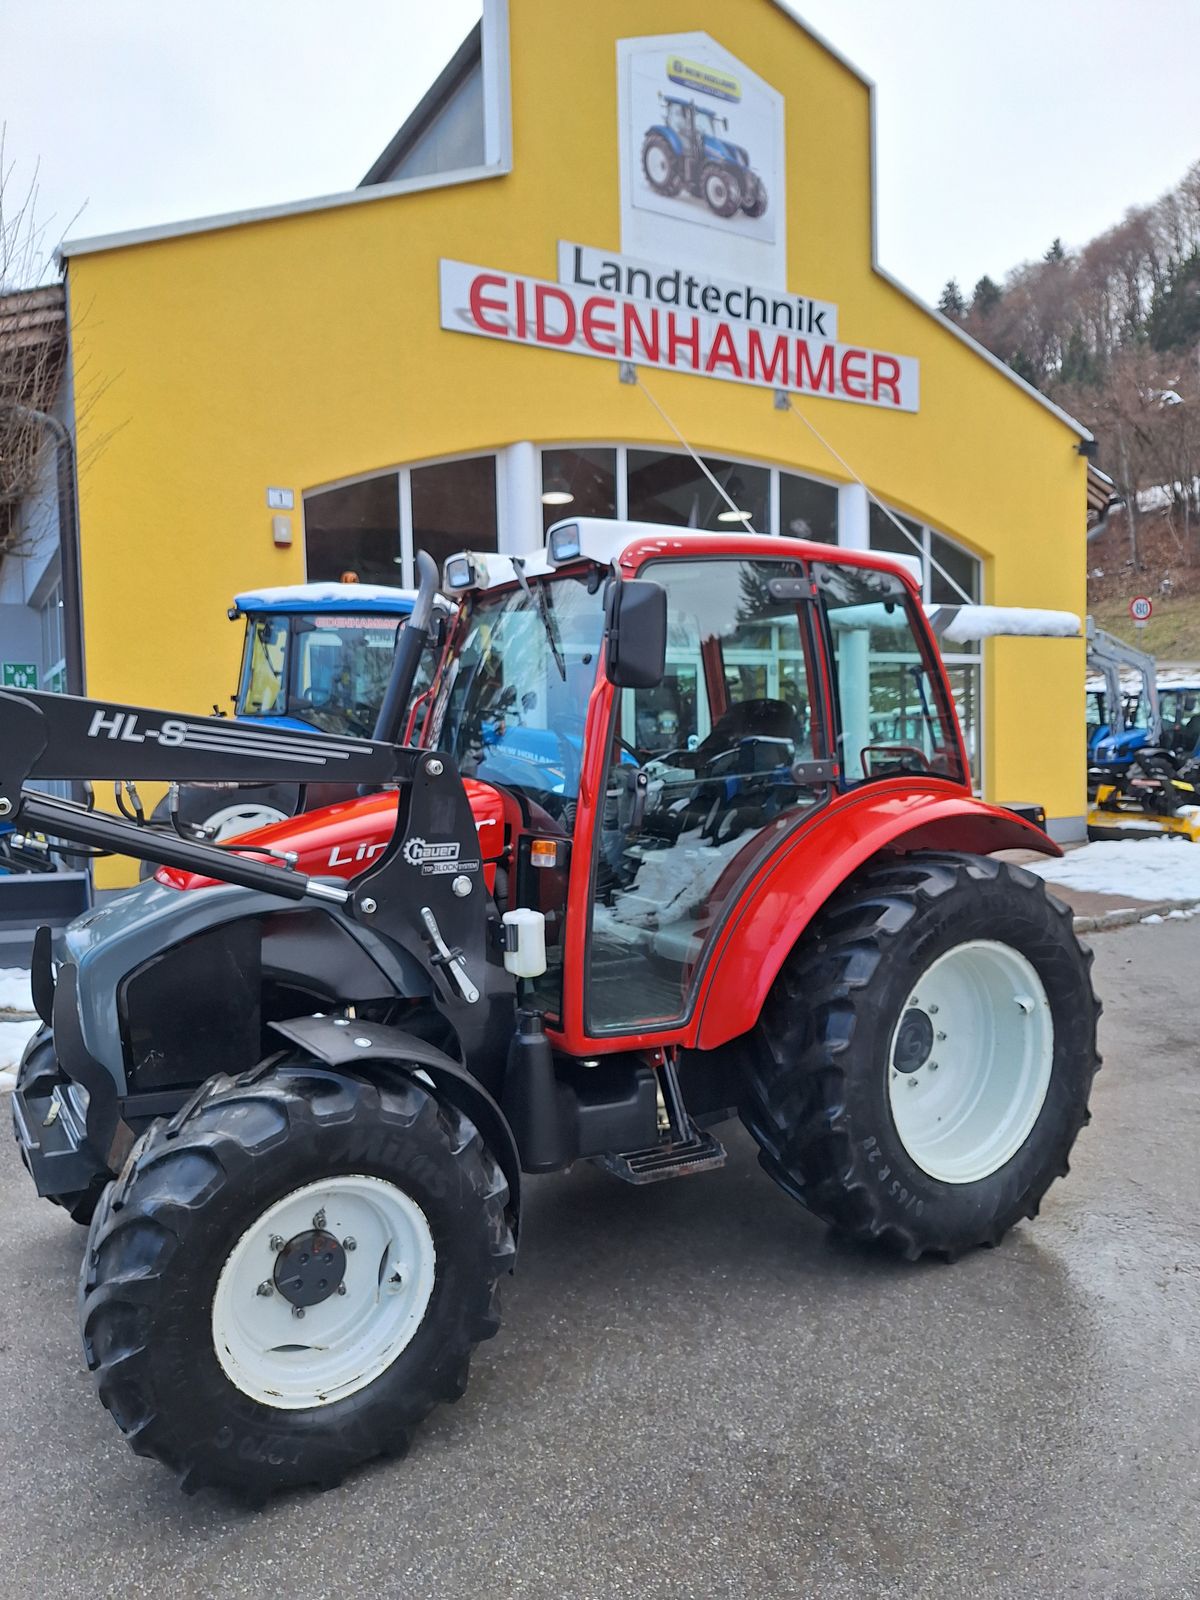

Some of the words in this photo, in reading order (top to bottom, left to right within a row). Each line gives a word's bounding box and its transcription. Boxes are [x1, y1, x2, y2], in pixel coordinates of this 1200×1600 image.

[572, 245, 827, 336] Landtechnik
[469, 273, 902, 406] EIDENHAMMER
[1136, 603, 1148, 615] 80
[87, 709, 188, 748] HL-S
[411, 843, 456, 859] hauer
